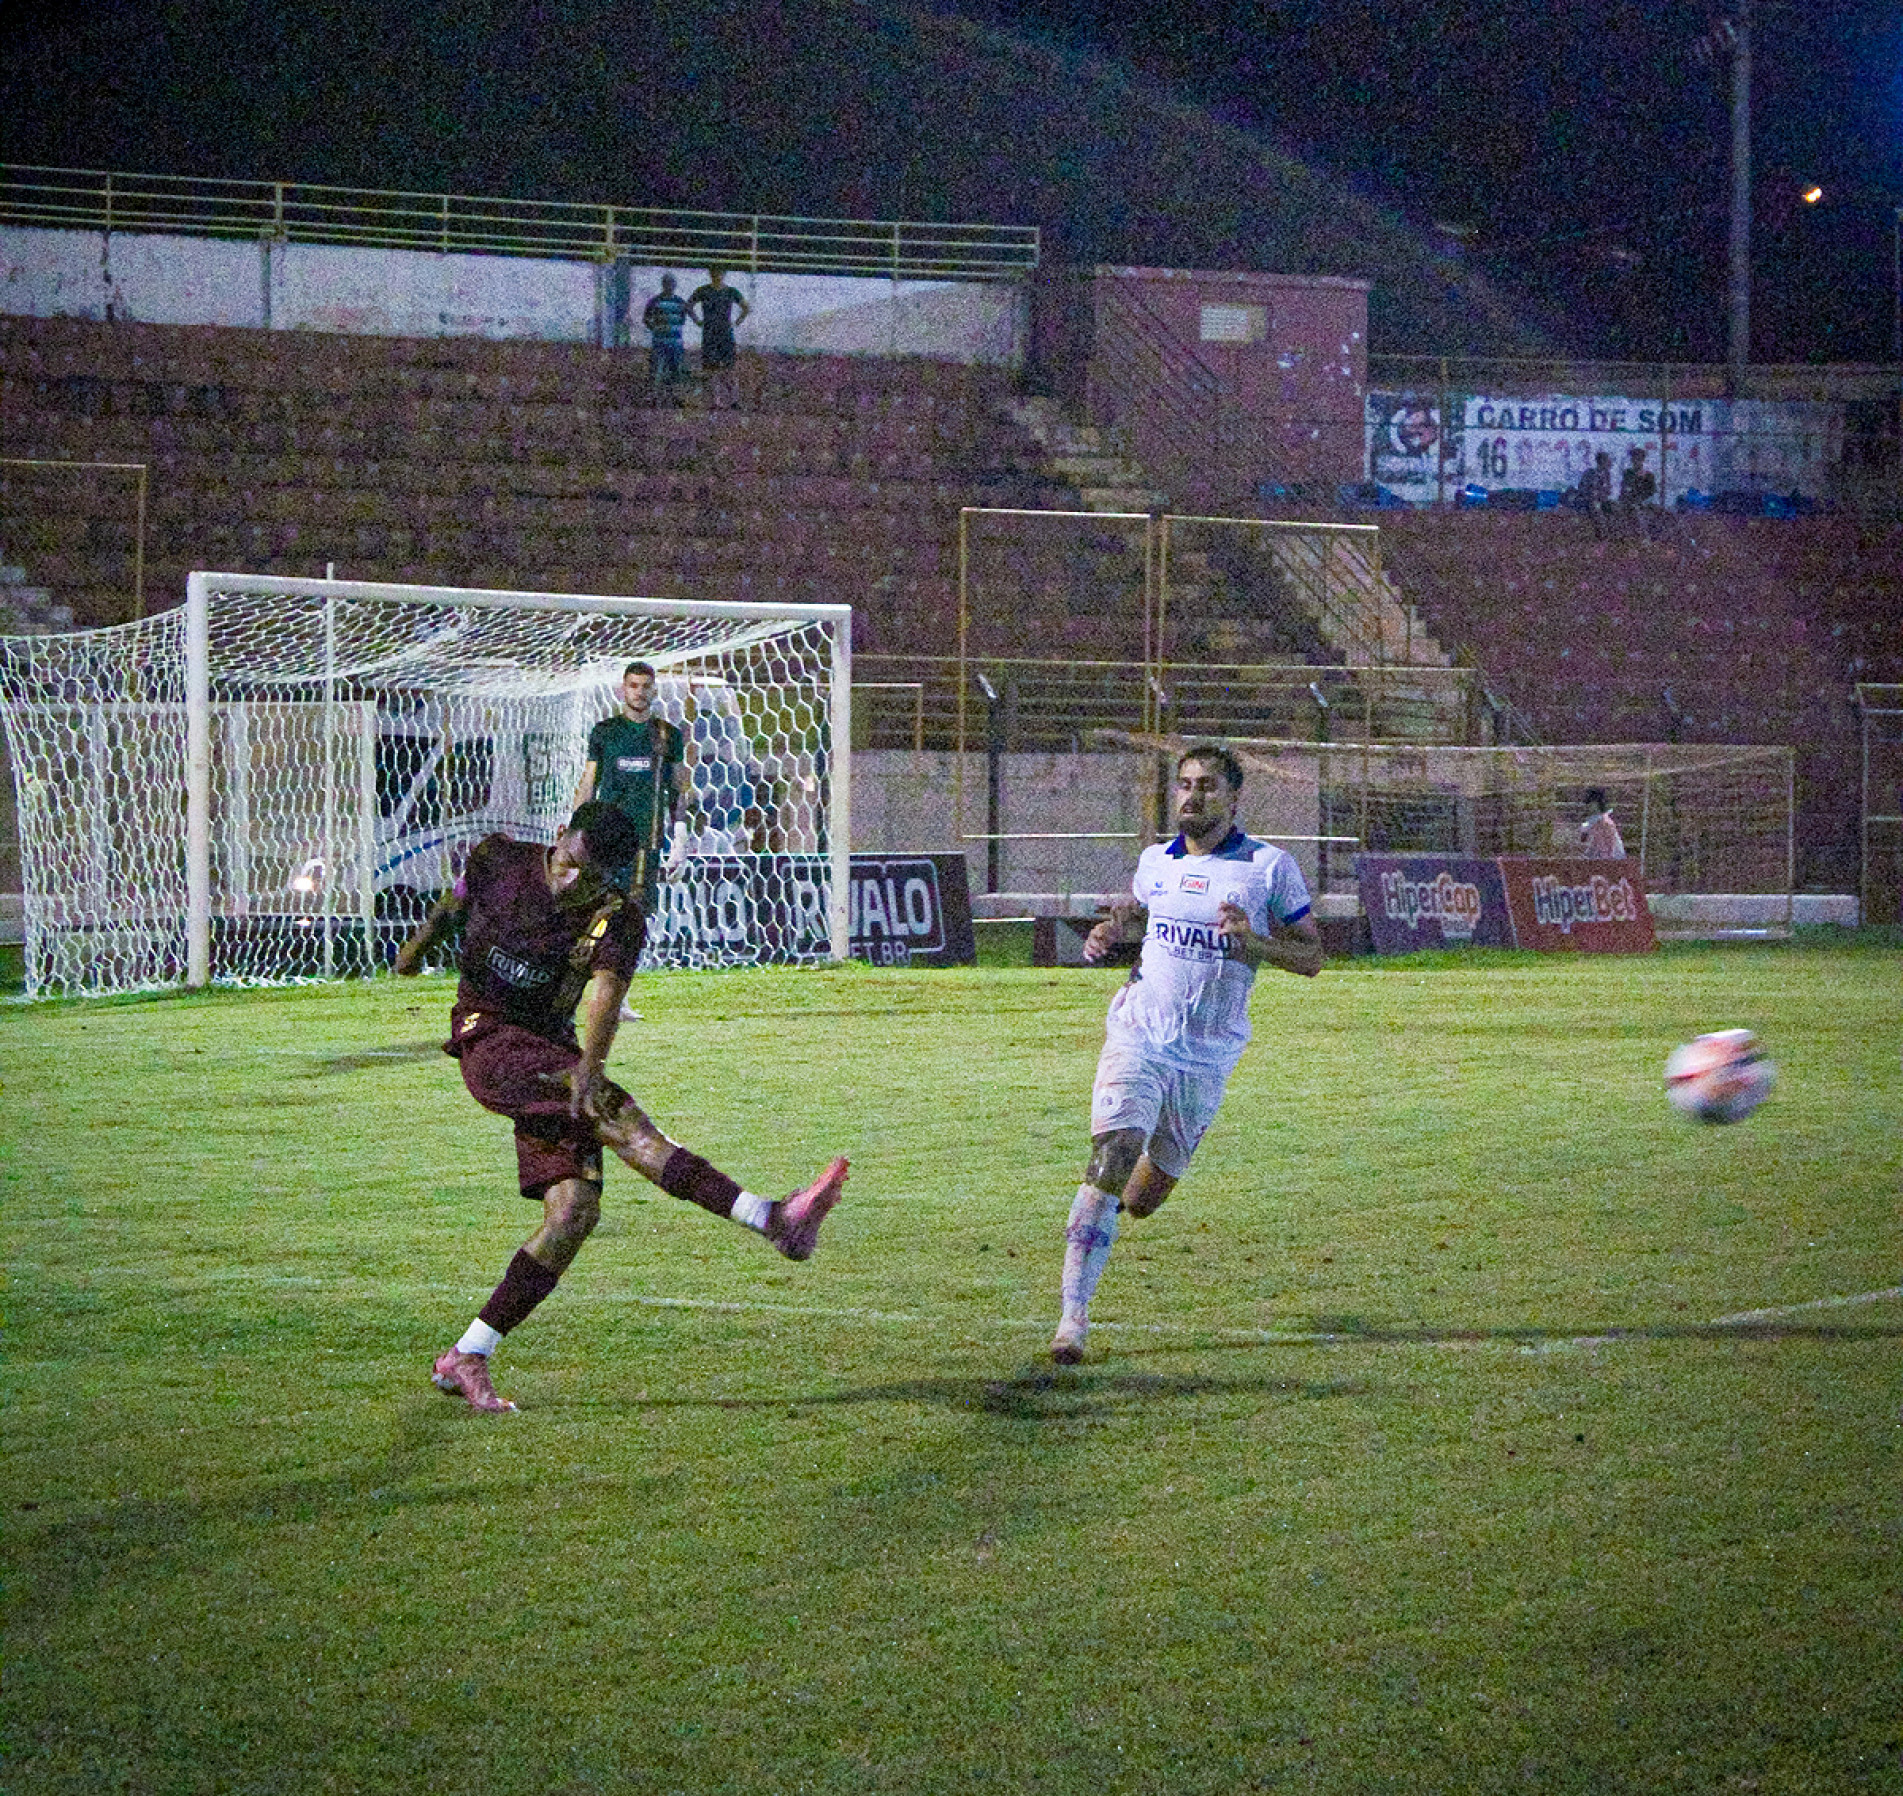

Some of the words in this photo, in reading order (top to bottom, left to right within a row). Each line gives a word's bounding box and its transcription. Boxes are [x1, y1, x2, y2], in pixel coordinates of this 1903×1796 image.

[1476, 404, 1579, 430] CARRO
[1590, 408, 1626, 431] DE
[1638, 408, 1701, 434] SOM
[645, 880, 747, 941] VALO
[1532, 874, 1637, 934] HiperBet
[1156, 922, 1231, 951] RIVALO
[491, 951, 551, 984] RIVALO
[850, 941, 911, 966] ET.BR
